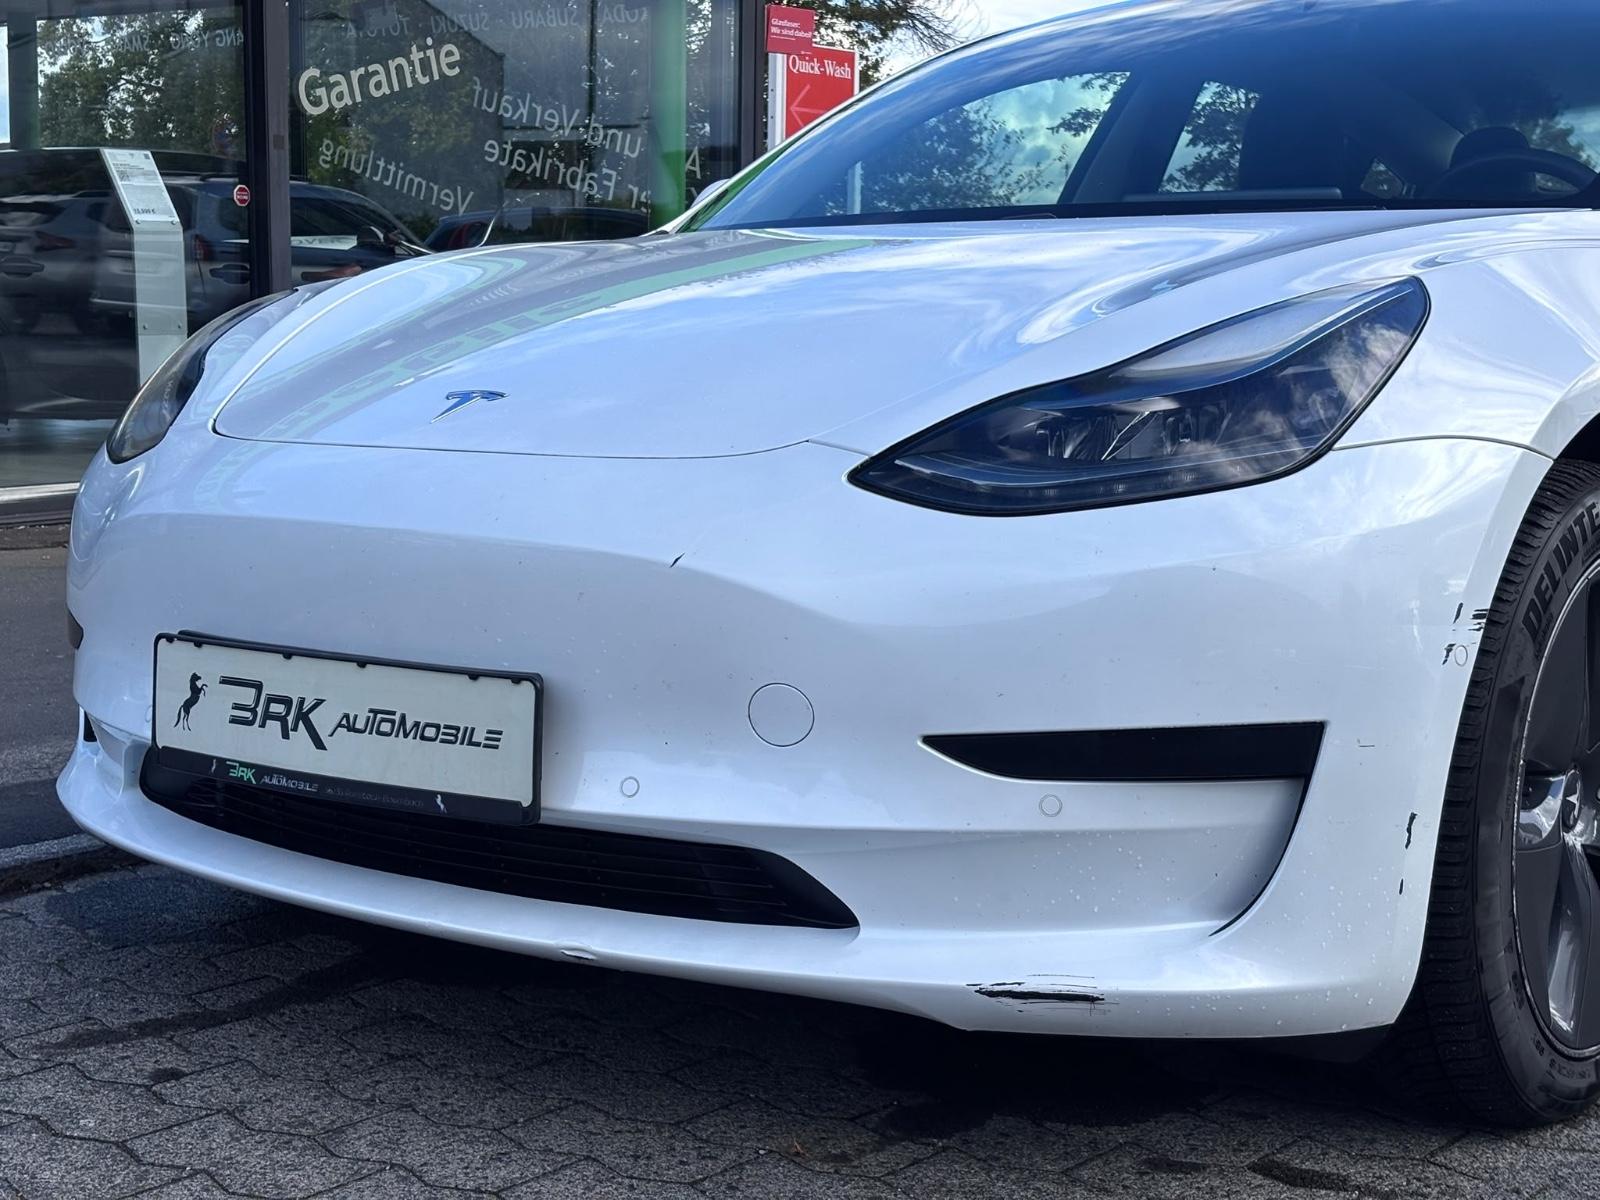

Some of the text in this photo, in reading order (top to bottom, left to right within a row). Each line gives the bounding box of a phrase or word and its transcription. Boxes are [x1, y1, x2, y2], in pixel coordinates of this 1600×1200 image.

[298, 36, 461, 116] Garantie
[788, 54, 852, 80] Quick-Wash
[218, 675, 504, 751] BRK AUTOMOBILE
[260, 774, 319, 792] AUTOMOBILE
